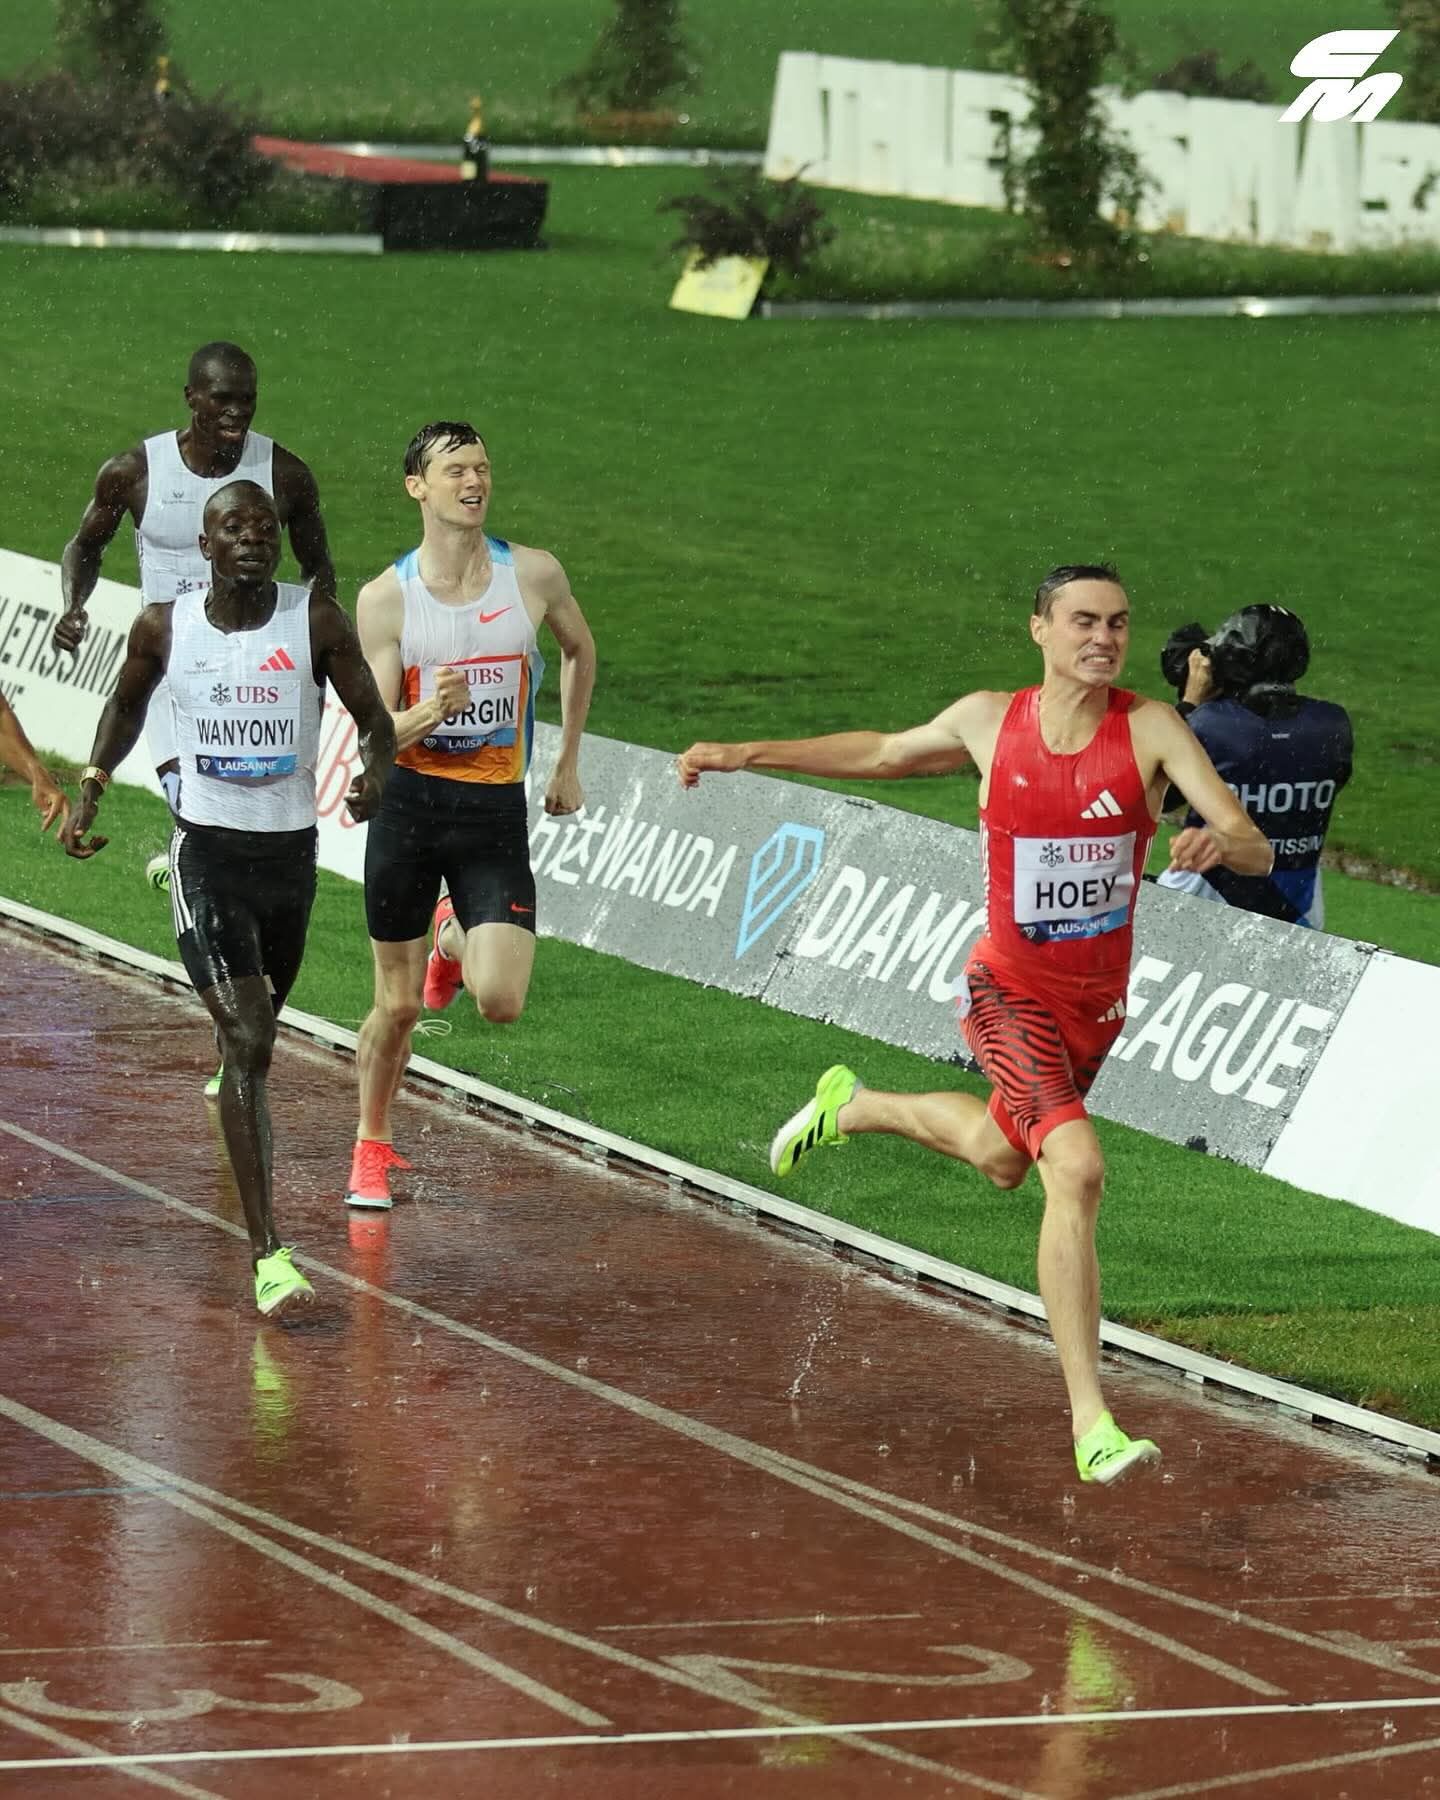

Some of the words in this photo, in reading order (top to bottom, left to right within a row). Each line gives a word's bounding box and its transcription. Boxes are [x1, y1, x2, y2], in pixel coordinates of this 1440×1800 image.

[464, 667, 504, 686] UBS
[235, 686, 280, 704] UBS
[196, 717, 294, 747] WANYONYI
[218, 760, 279, 771] LAUSANNE
[1068, 842, 1116, 863] UBS
[587, 815, 739, 918] WANDA
[1035, 874, 1118, 910] HOEY
[1049, 915, 1111, 935] LAUSANNE
[1108, 954, 1334, 1109] EAGUE
